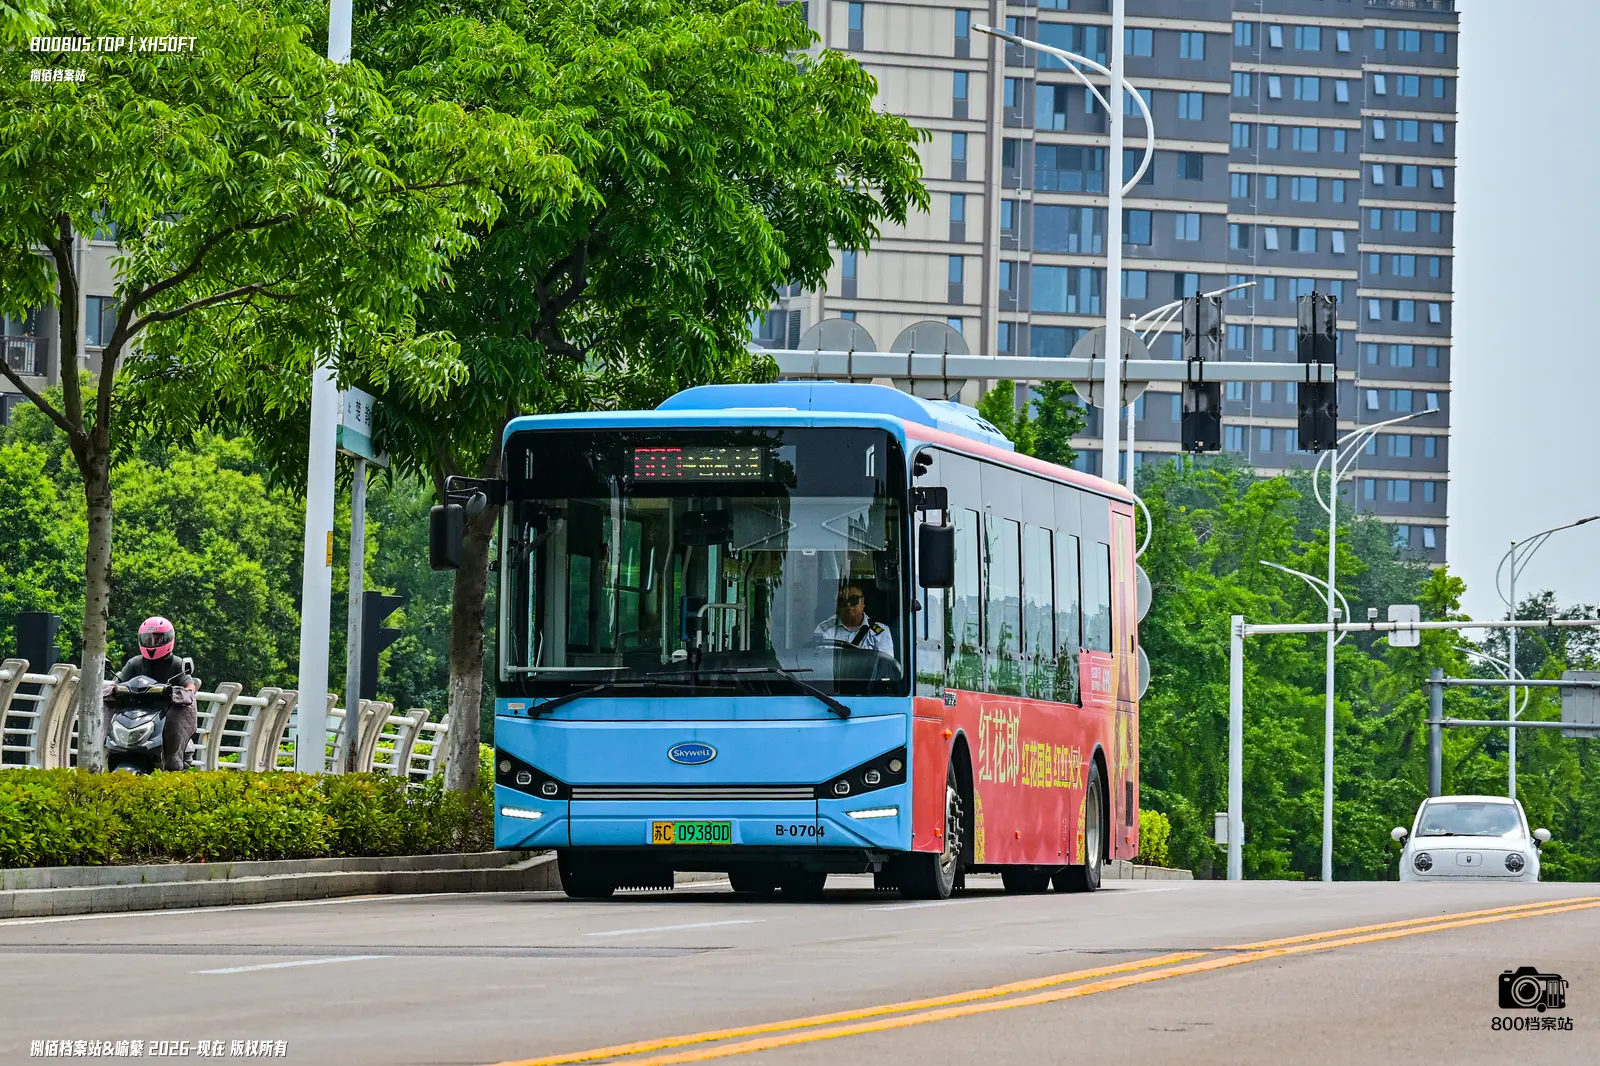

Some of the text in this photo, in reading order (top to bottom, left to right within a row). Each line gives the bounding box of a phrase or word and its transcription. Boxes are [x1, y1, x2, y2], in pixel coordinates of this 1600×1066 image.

[673, 749, 711, 757] Skywell
[979, 704, 1020, 787] 红花郎
[1022, 740, 1052, 789] 红花国色
[775, 825, 825, 837] B-0704
